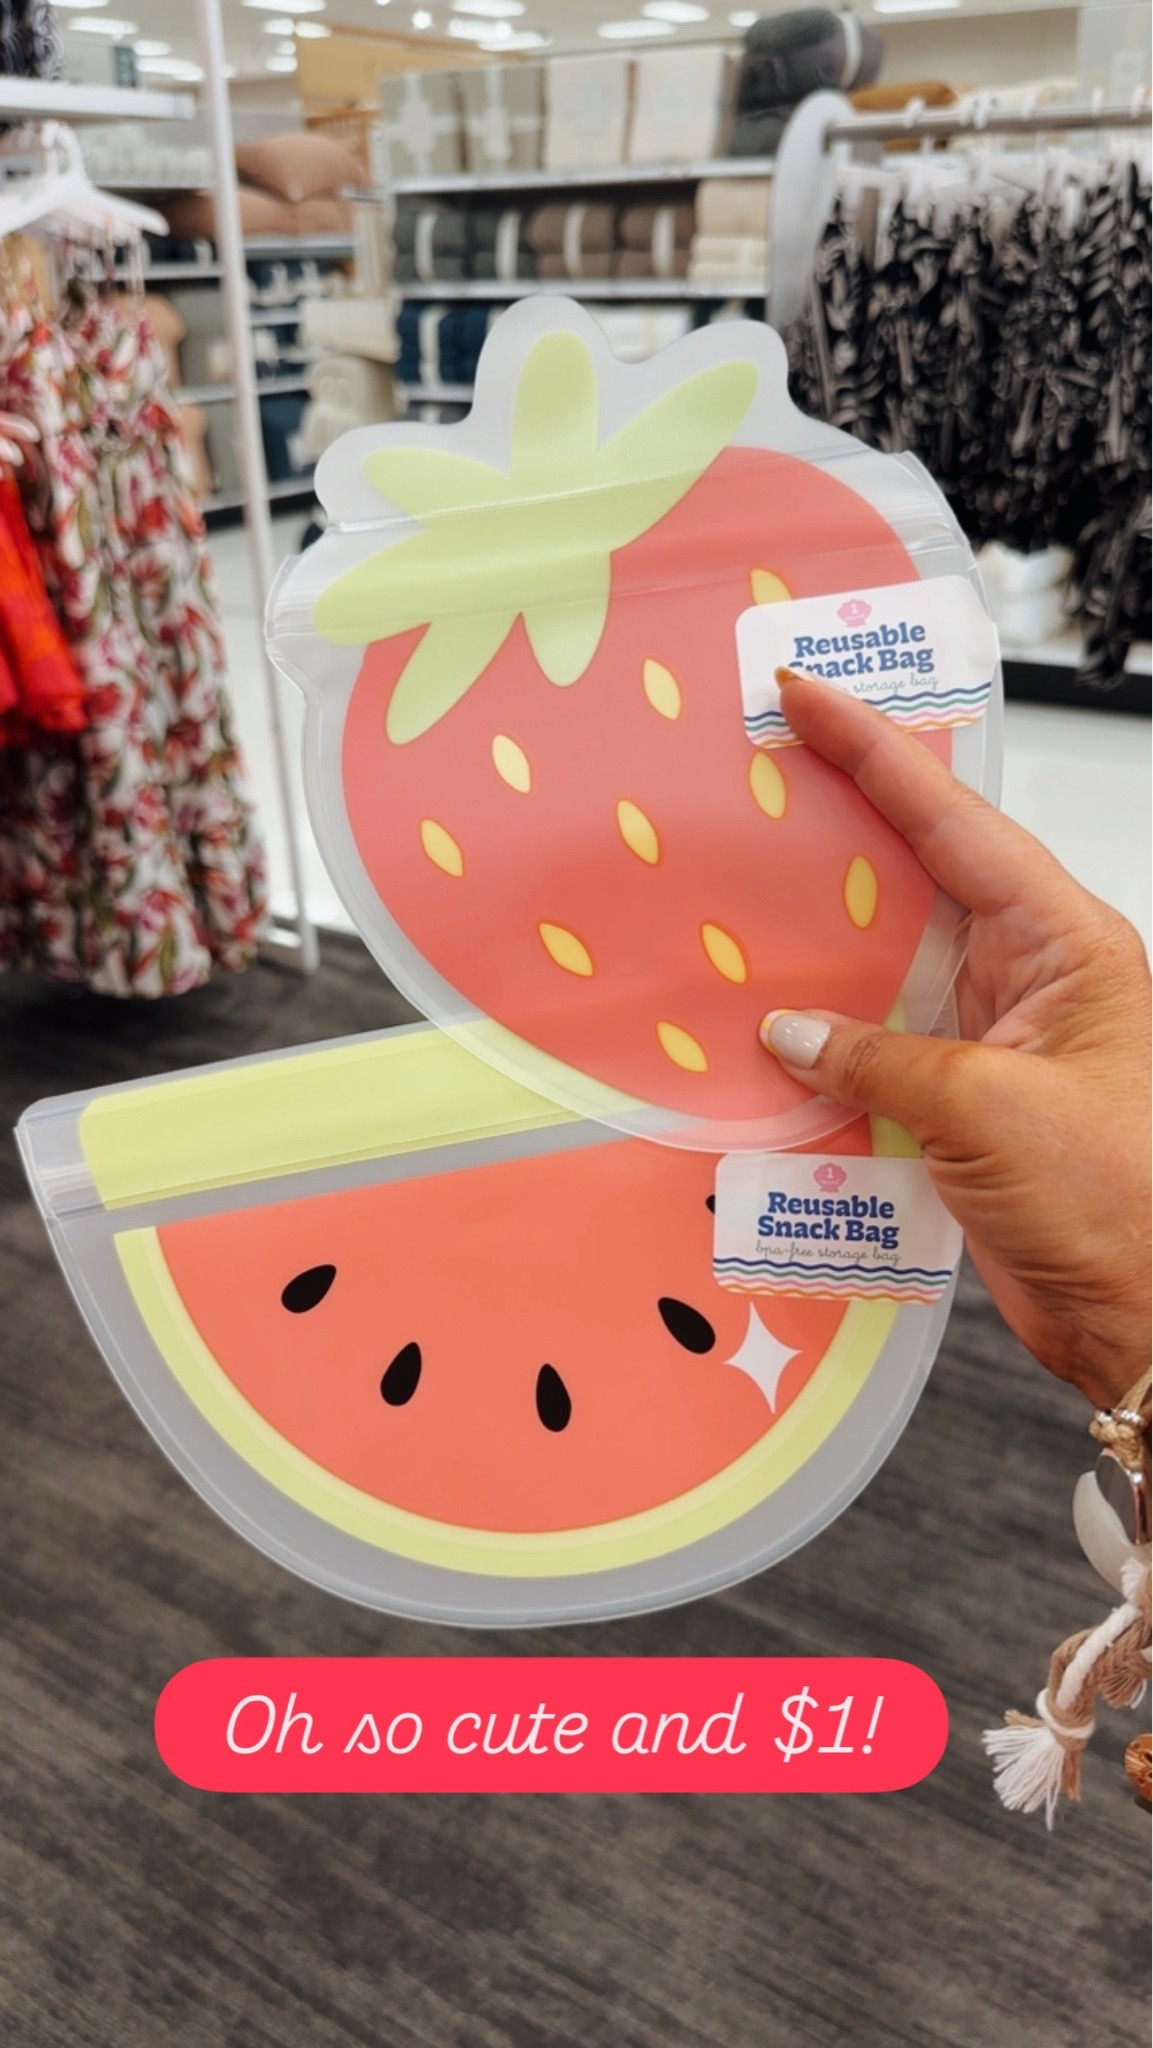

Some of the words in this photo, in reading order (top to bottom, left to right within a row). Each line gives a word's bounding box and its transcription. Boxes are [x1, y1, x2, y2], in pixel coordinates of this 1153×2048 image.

[794, 622, 926, 658] Reusable
[878, 648, 935, 674] Bag
[853, 680, 906, 698] storage
[910, 672, 939, 691] bag
[826, 1167, 834, 1179] 1
[767, 1191, 895, 1219] Reusable
[757, 1215, 840, 1241] Snack
[845, 1220, 899, 1249] Bag
[756, 1240, 813, 1262] bpa-free
[817, 1246, 868, 1264] storage
[872, 1246, 901, 1266] bag
